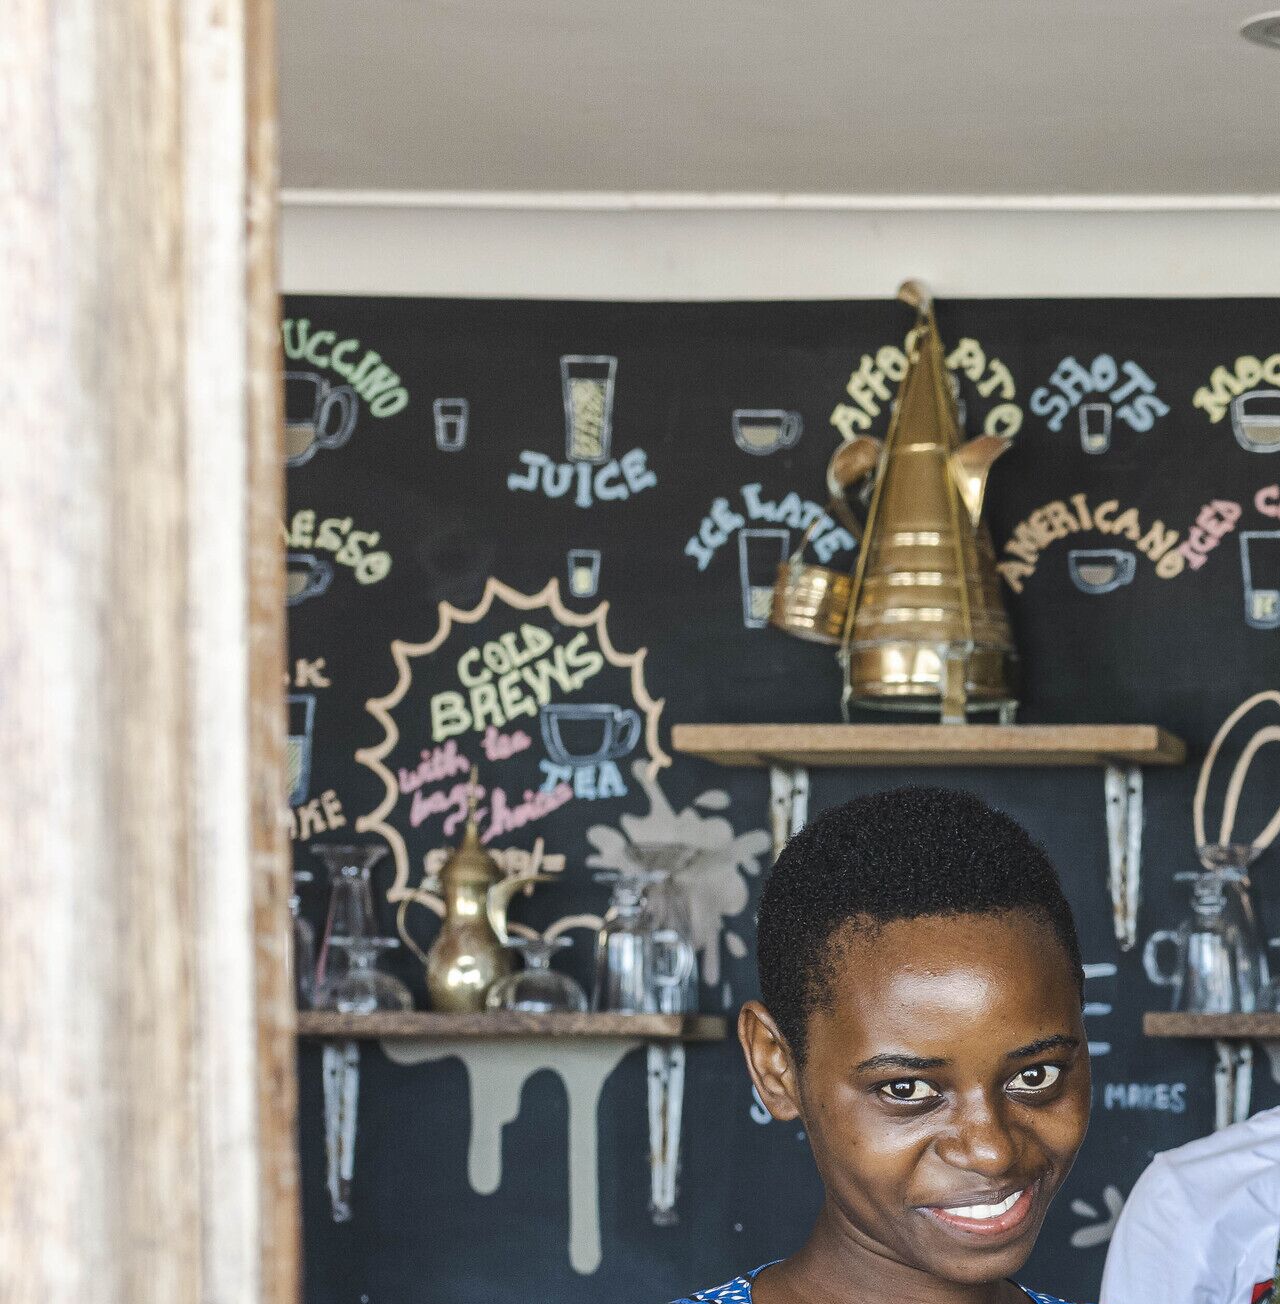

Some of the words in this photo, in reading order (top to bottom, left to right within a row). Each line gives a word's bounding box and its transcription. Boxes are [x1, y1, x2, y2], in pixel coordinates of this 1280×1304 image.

[1030, 353, 1170, 432] SHOTS
[507, 447, 658, 509] JUICE
[284, 508, 393, 585] ESSO
[685, 496, 746, 572] ICE
[996, 492, 1186, 595] AMERICANO
[1176, 499, 1242, 571] ICED
[430, 632, 604, 742] BREWS
[457, 622, 554, 689] COLD
[538, 758, 628, 801] TEA
